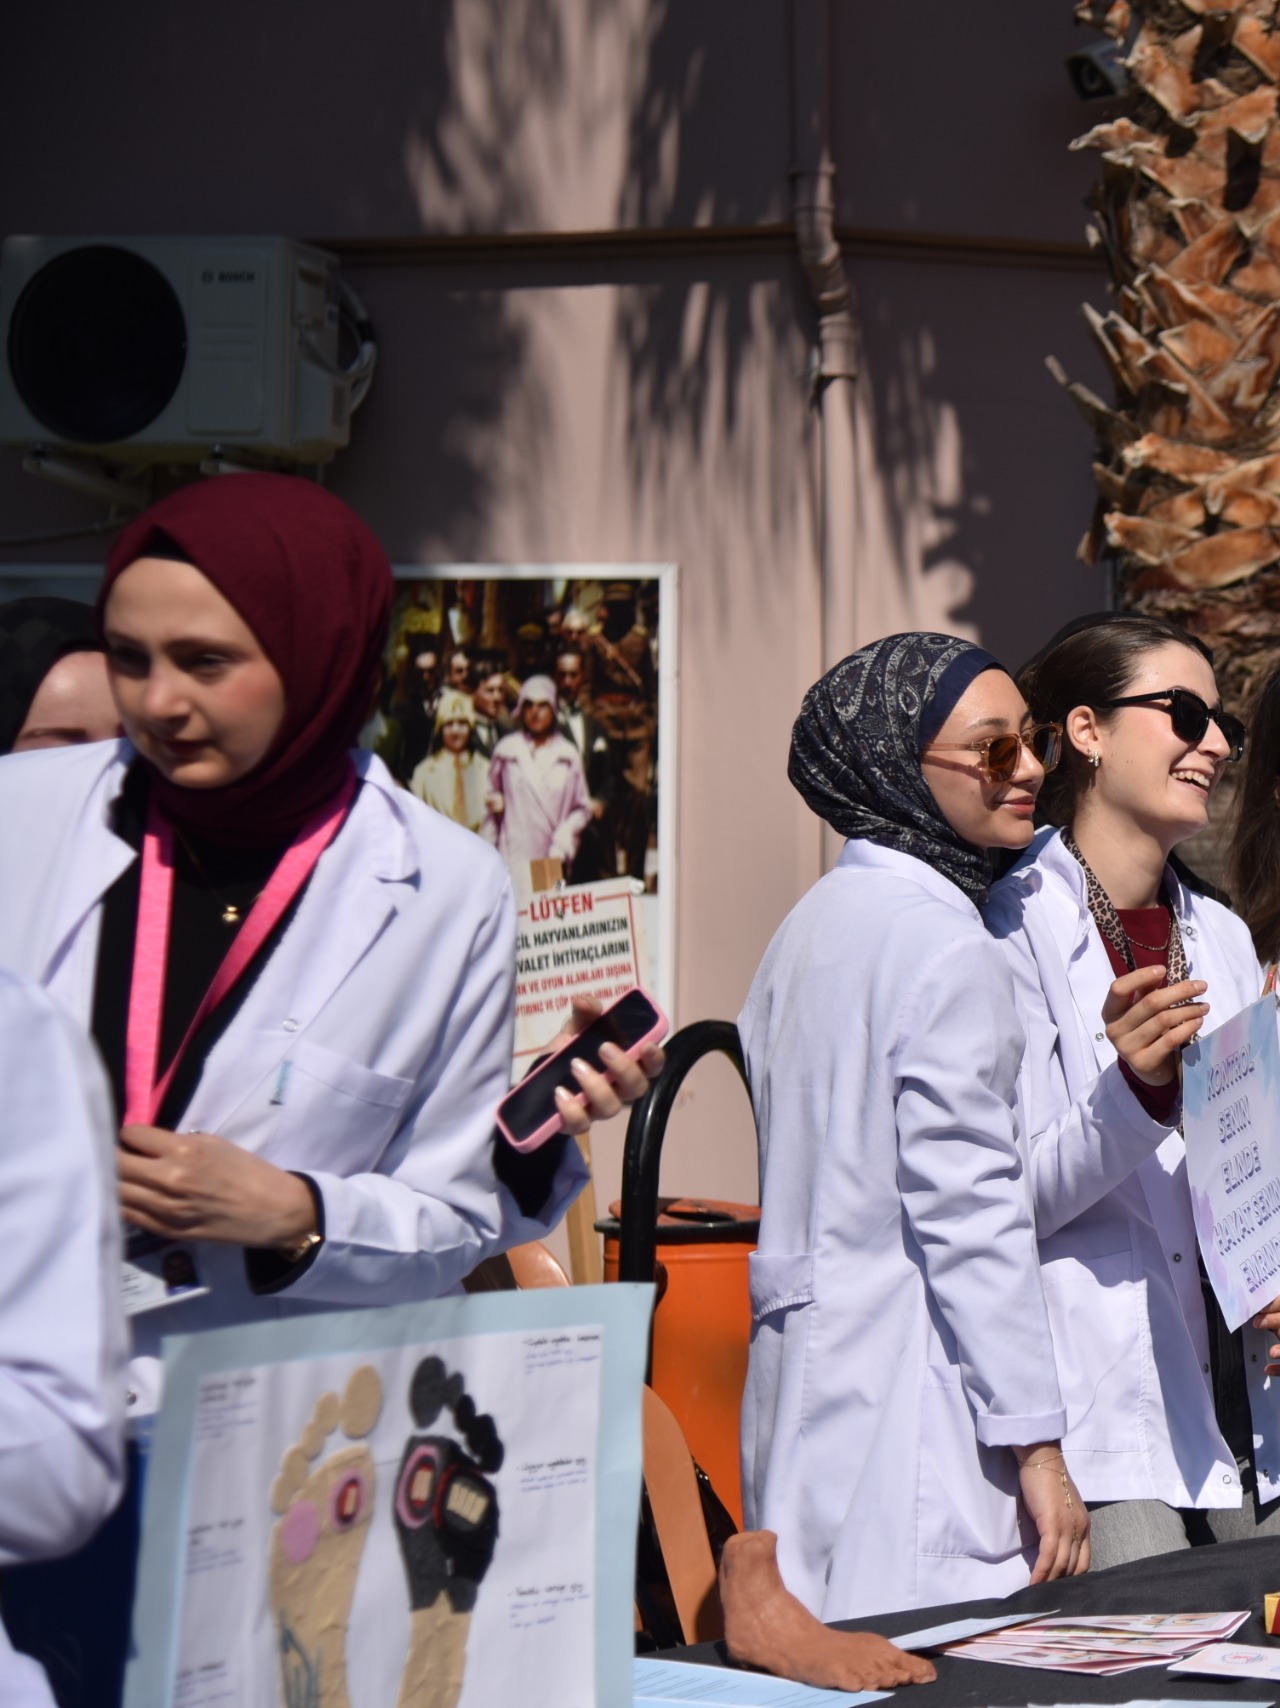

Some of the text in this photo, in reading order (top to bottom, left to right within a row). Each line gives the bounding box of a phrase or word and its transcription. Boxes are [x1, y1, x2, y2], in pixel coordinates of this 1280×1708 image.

[530, 892, 593, 922] LÜTFEN
[533, 917, 629, 947] HAYVANLARINIZIN
[552, 940, 630, 967] İHTİYAÇLARINI
[1206, 1042, 1255, 1102] KONTROL
[1213, 1201, 1255, 1257] HAYAT
